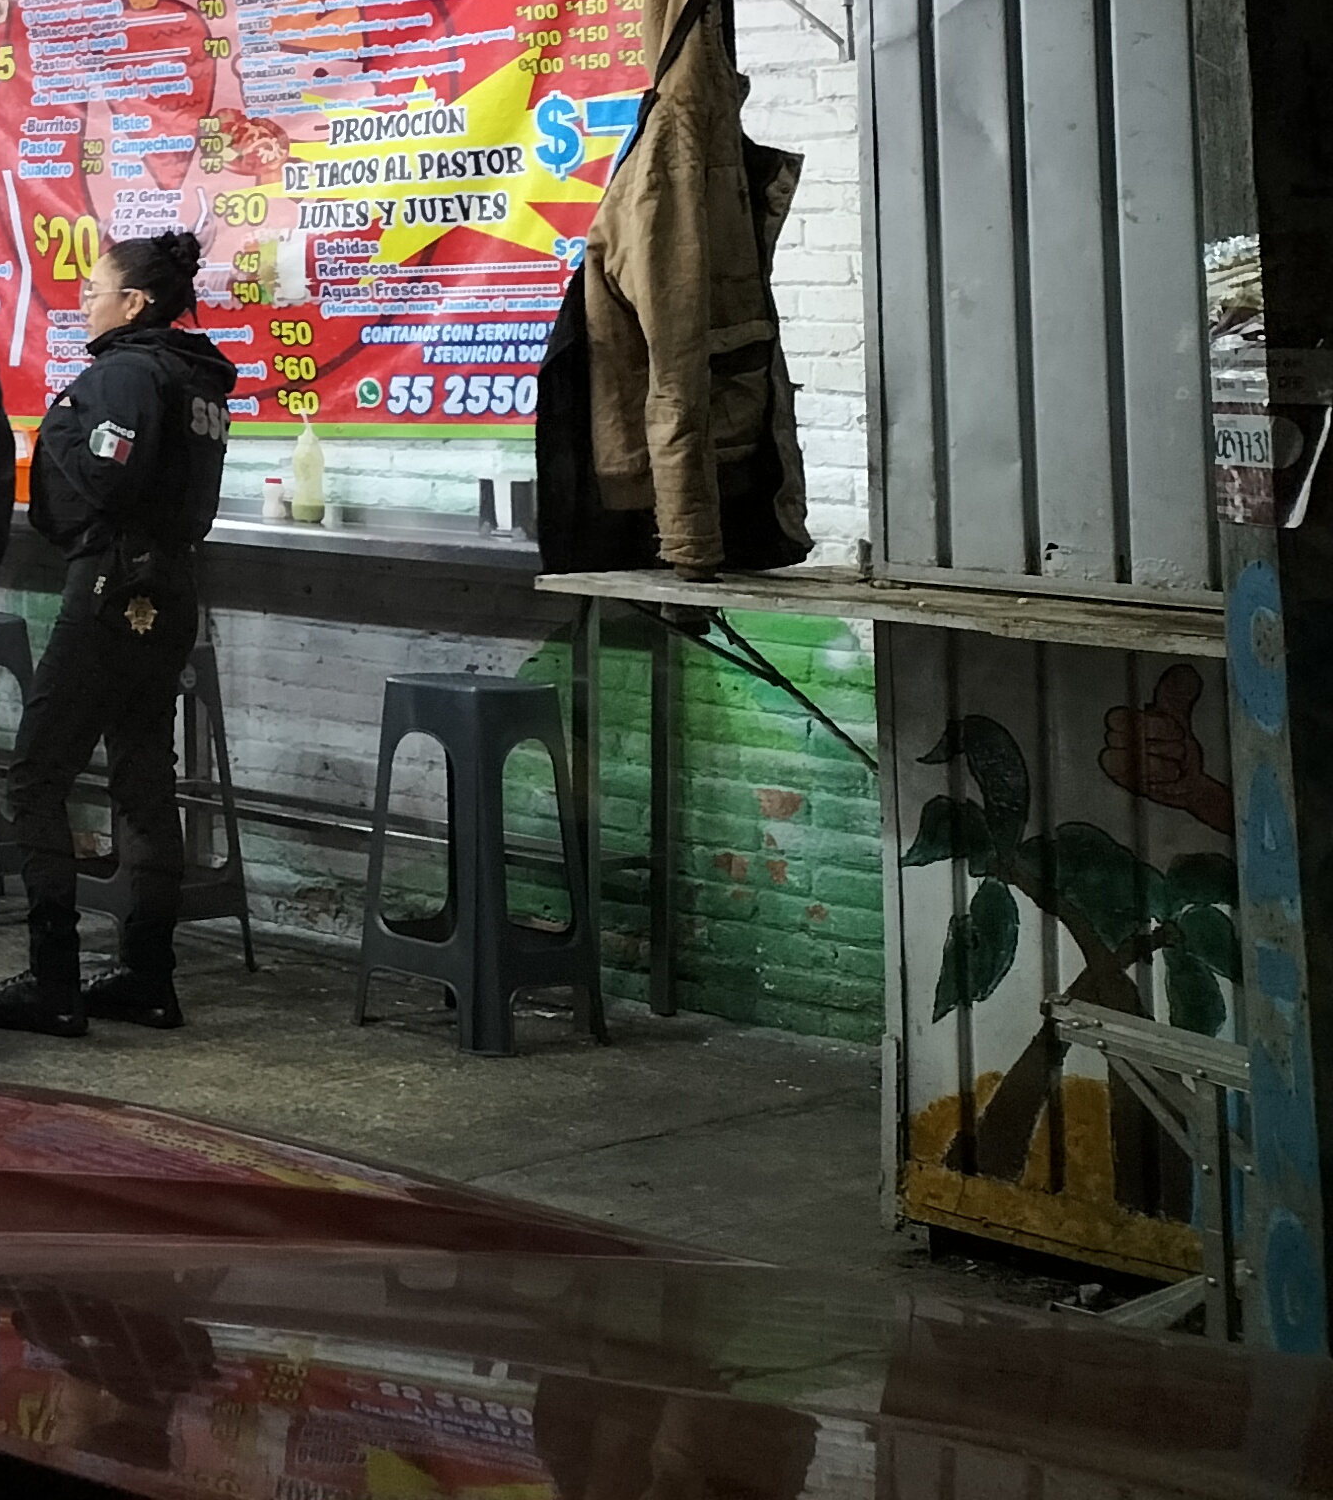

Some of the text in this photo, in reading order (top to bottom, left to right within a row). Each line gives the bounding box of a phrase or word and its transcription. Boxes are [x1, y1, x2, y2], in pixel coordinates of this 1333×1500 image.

[516, 3, 558, 21] $100
[91, 19, 127, 35] queso
[518, 25, 609, 48] $100 $150
[204, 38, 231, 58] $70
[136, 61, 184, 79] tortillas
[519, 52, 611, 75] $100 $150
[32, 91, 47, 104] de
[150, 78, 191, 96] queso)
[112, 115, 221, 133] Bistec $70
[329, 99, 467, 146] PROMOCIÓN
[20, 134, 223, 156] Pastor $60 Campechano $70
[19, 156, 223, 179] Suadero $70 Tripa $75
[284, 146, 526, 191] DE TACOS AL PASTOR
[116, 190, 181, 205] 1/2 Gringa
[114, 208, 177, 219] 1/2 Pocha
[214, 193, 267, 226] $30
[298, 193, 507, 229] LUNES Y JUEVES
[112, 224, 130, 236] 1/2
[35, 214, 101, 281] $20
[315, 241, 379, 257] Bebidas
[234, 252, 259, 272] $45
[317, 262, 398, 277] Refrescos
[233, 282, 260, 303] $50
[321, 283, 439, 301] Aguas Frescas
[323, 301, 379, 318] (Horchata
[382, 302, 403, 313] con
[209, 326, 253, 344] queso)
[270, 320, 312, 346] $50
[361, 323, 546, 343] CONTAMOS CON SERVICIO
[423, 344, 515, 363] Y SERVICIO A
[273, 355, 317, 380] $60
[277, 389, 320, 415] $60
[387, 374, 537, 415] 55 2550
